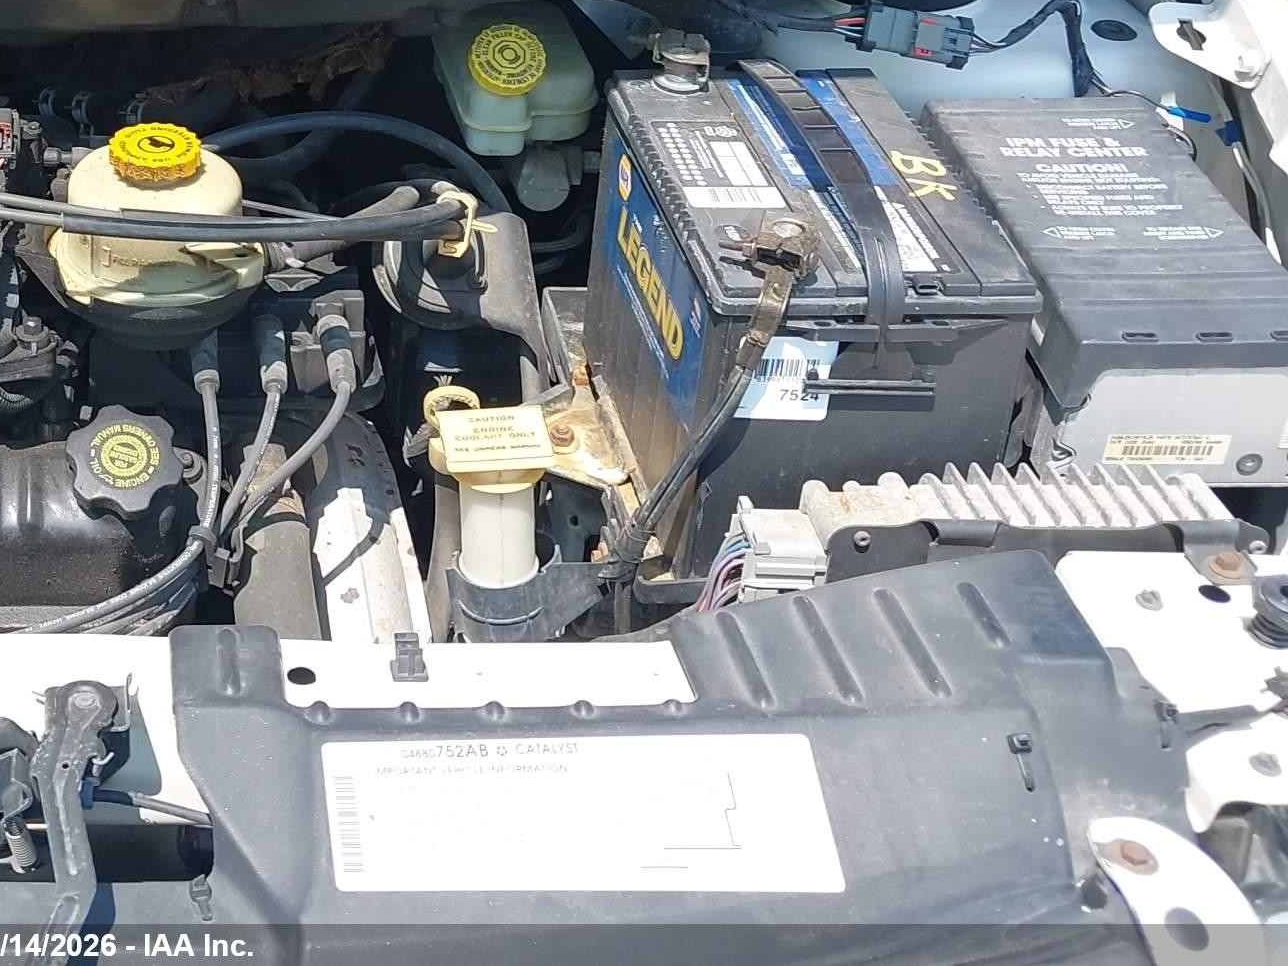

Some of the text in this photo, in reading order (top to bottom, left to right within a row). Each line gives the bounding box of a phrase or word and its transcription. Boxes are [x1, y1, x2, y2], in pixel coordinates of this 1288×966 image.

[1005, 137, 1121, 147] IPM FUSE &
[999, 147, 1150, 157] RELAY CENTER
[1035, 163, 1129, 173] CAUTION!
[617, 206, 684, 360] LEGEND
[467, 415, 516, 423] CAUTION
[472, 425, 515, 434] ENGINE
[455, 431, 536, 442] COOLANT ONLY
[90, 424, 160, 466] SEE OWNERS MANUAL
[90, 457, 150, 488] ENGINE OIL
[514, 742, 579, 755] CATALYST
